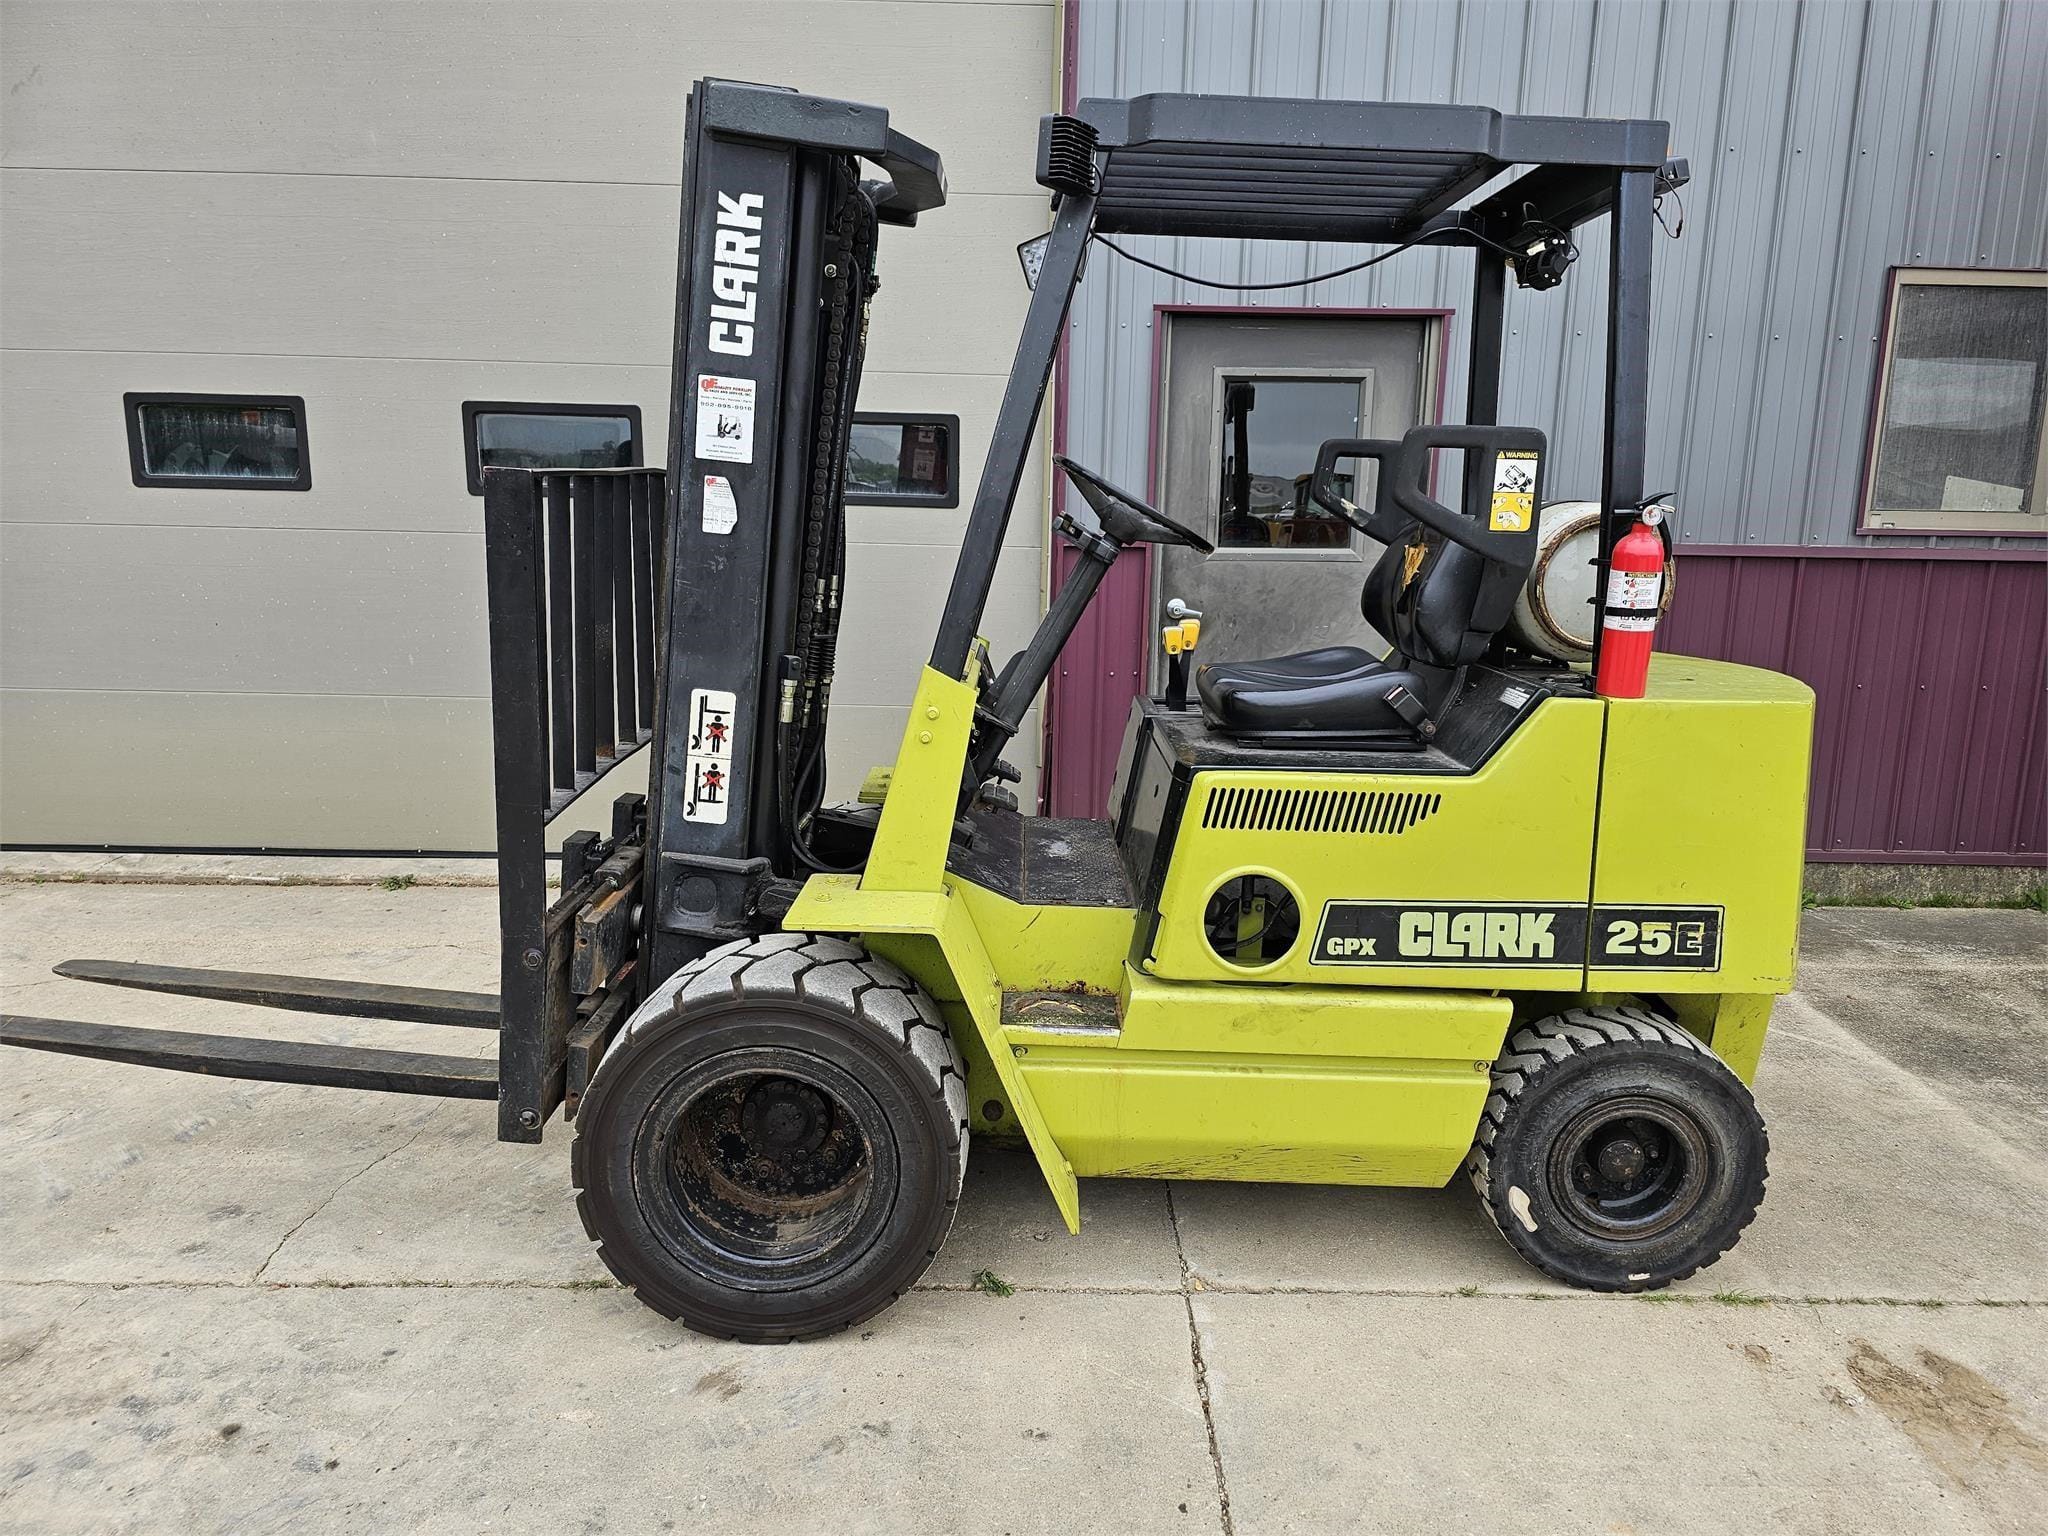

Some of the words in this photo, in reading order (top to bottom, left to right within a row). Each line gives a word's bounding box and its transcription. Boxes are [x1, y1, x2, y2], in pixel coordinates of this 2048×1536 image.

[708, 190, 764, 357] CLARK
[1505, 451, 1538, 459] WARNING
[1326, 937, 1377, 956] GPX
[1397, 911, 1556, 959] CLARK
